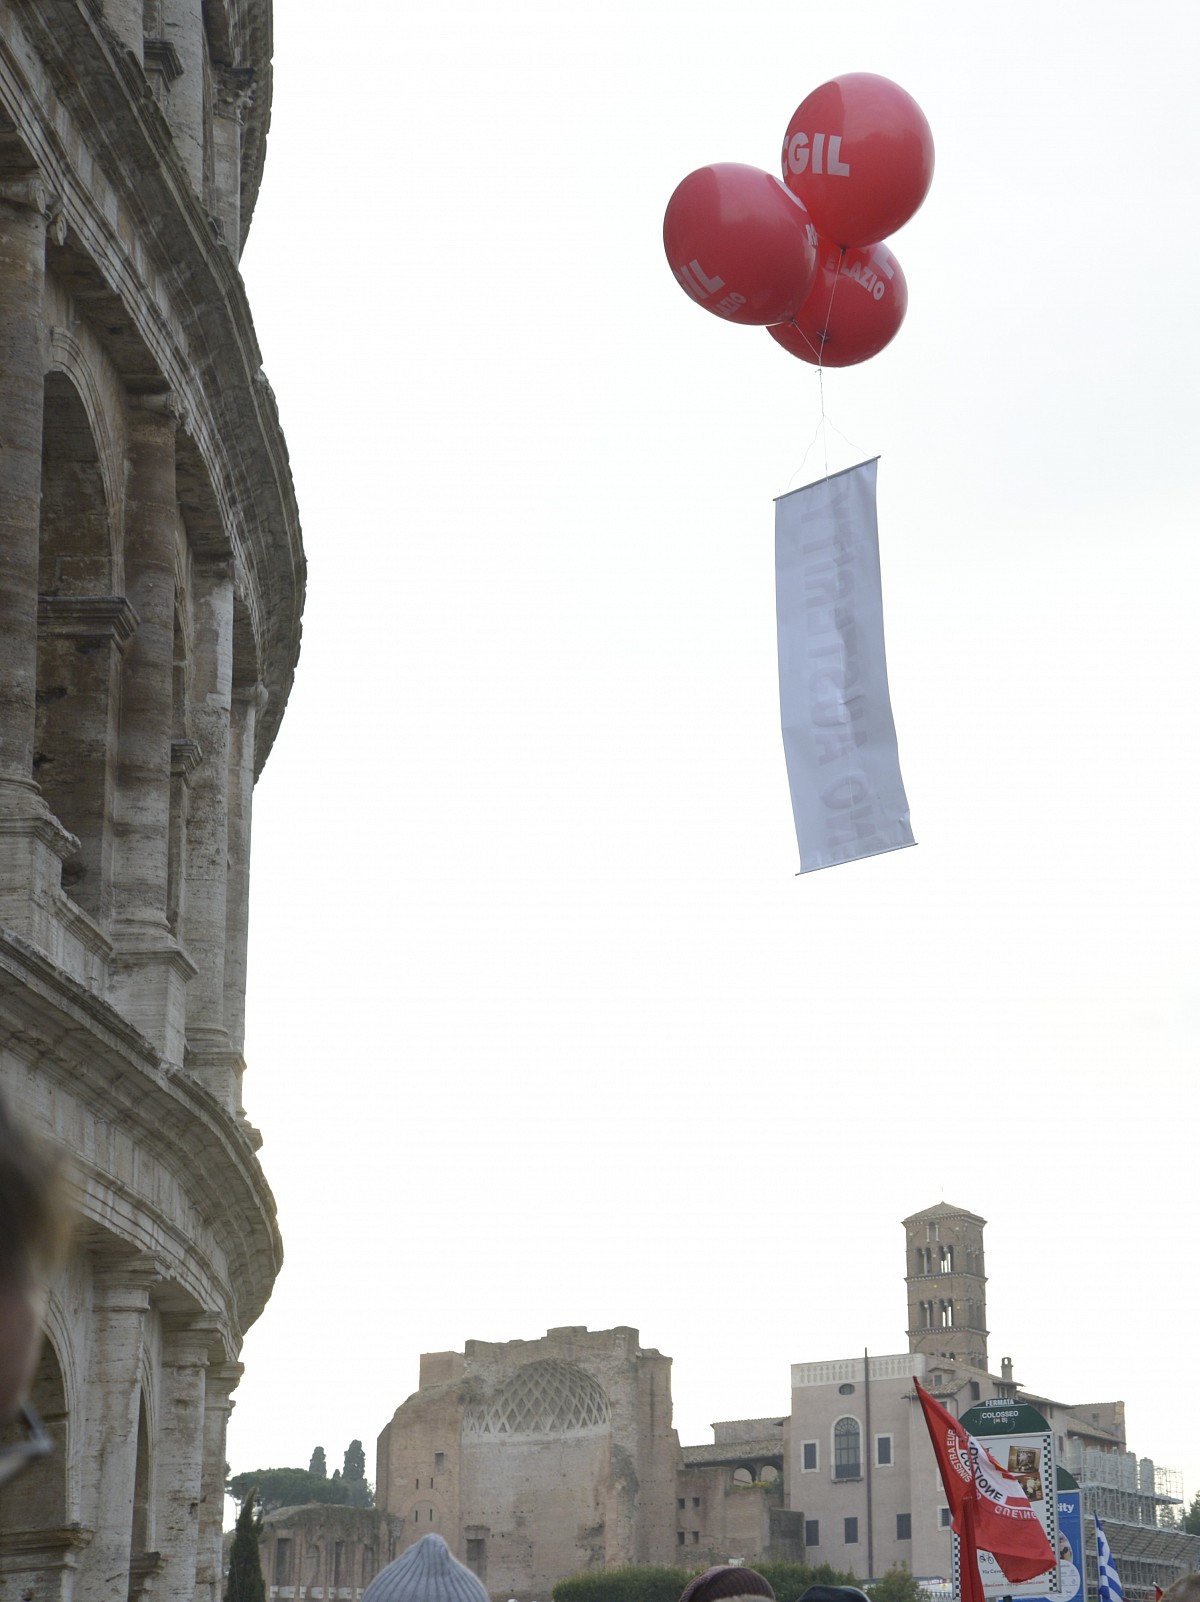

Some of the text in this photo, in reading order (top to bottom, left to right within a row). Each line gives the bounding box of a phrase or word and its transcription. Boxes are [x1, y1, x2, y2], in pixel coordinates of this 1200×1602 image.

[985, 1399, 1015, 1407] FERMATA
[981, 1410, 1019, 1419] COLOSSEO
[948, 1448, 972, 1483] SINISTRA
